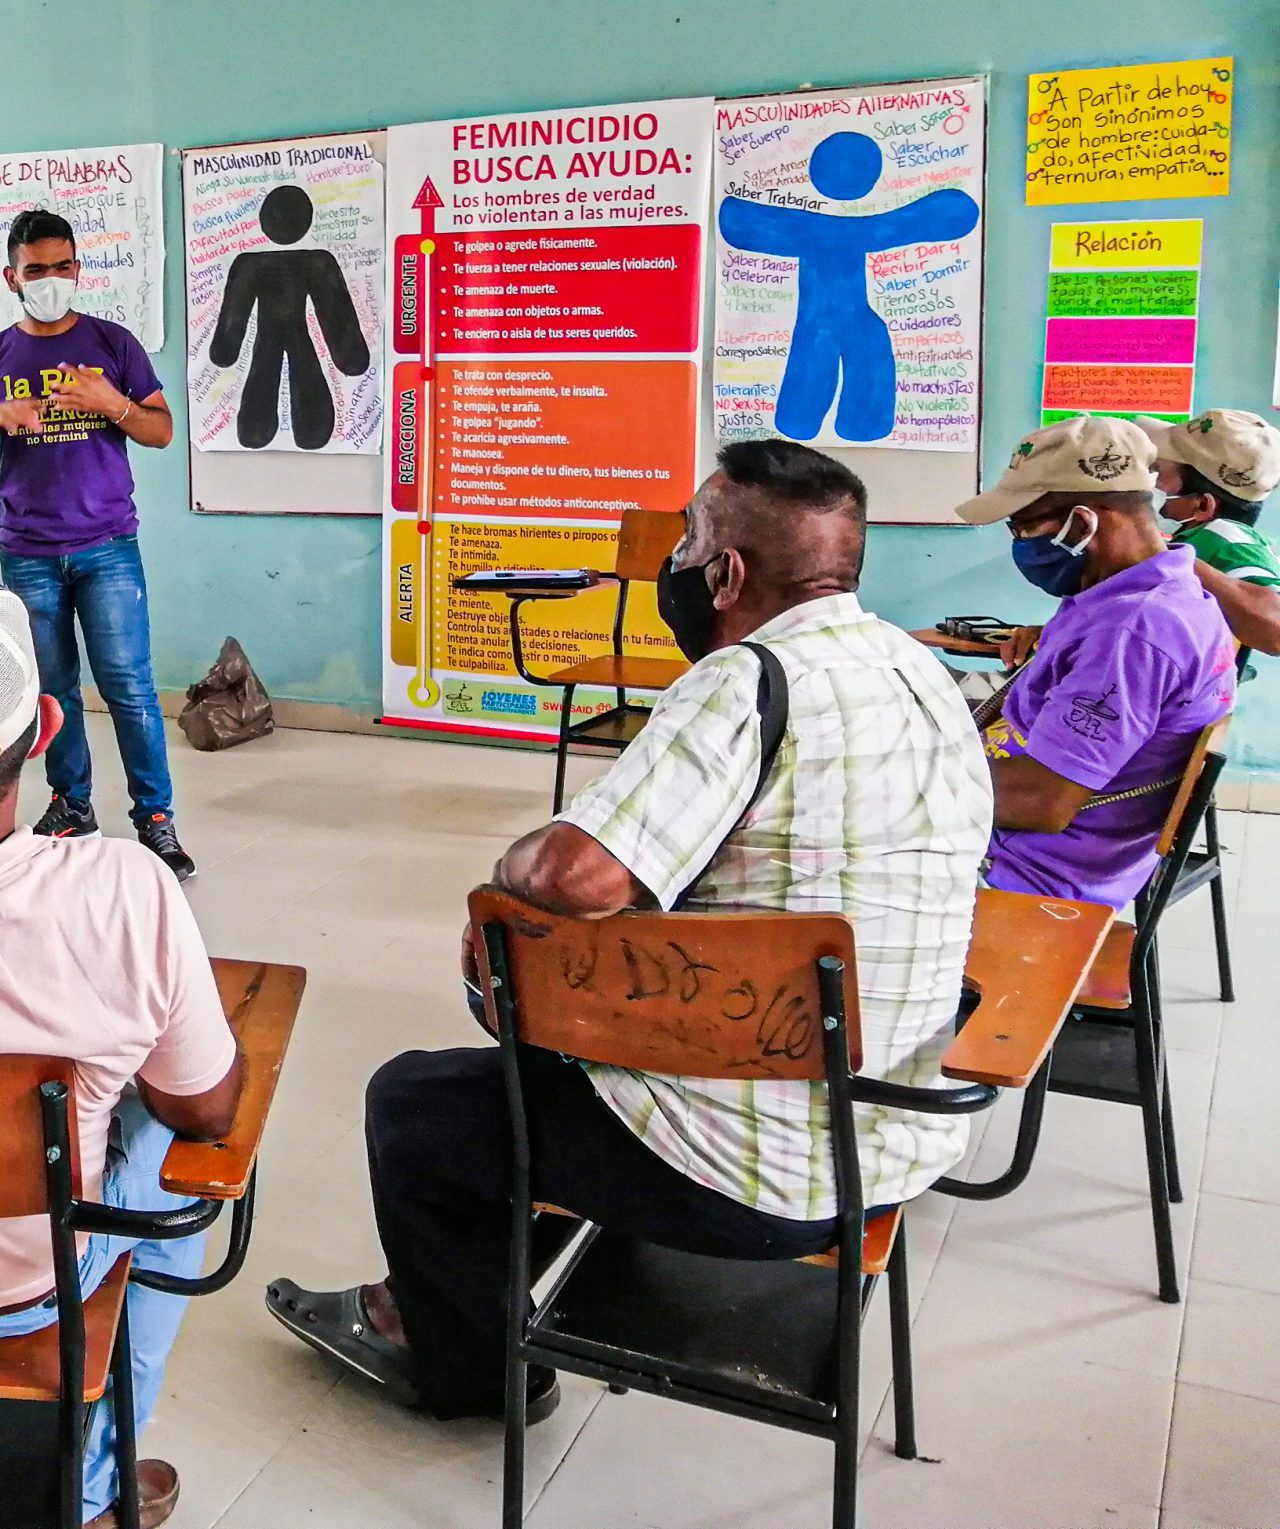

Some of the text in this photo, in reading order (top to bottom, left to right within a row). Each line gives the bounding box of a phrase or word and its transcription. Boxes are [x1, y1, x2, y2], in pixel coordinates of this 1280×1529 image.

[1048, 87, 1067, 112] A
[1147, 74, 1172, 100] de
[1176, 75, 1211, 103] hoy
[453, 113, 658, 151] FEMINICIDIO
[1045, 132, 1071, 149] de
[18, 158, 43, 182] DE
[47, 154, 133, 189] PALABRAS
[453, 148, 692, 185] BUSCA AYUDA:
[55, 192, 127, 215] ENFOQUE
[453, 184, 655, 208] Los hombres de verdad
[724, 181, 762, 200] Saber
[765, 188, 829, 210] Trabajar
[453, 204, 689, 225] no violentan a las mujeres.
[453, 241, 464, 252] Te
[465, 241, 495, 254] golpea
[496, 242, 502, 251] o
[505, 239, 538, 253] agrede
[1076, 230, 1162, 257] Relación
[453, 256, 678, 274] Te fuerza a tener relaciones sexuales (violación).
[400, 253, 417, 336] URGENTE
[453, 284, 558, 296] Te amenaza de muerte.
[453, 305, 604, 319] Te amenaza con objetos o armas.
[453, 328, 465, 339] Te
[465, 328, 500, 339] encierra
[502, 329, 507, 338] o
[533, 327, 546, 338] de
[548, 328, 564, 338] tus
[565, 329, 591, 338] seres
[592, 326, 638, 340] queridos.
[3, 375, 32, 401] la
[453, 385, 608, 398] Te ofende verbalmente, te insulta.
[43, 424, 60, 432] las
[63, 420, 107, 432] mujeres
[452, 416, 463, 427] Te
[463, 417, 492, 429] golpea
[27, 431, 89, 445] no termina
[399, 388, 416, 485] REACCIONA
[451, 447, 504, 459] Te manosea.
[451, 462, 670, 480] Maneja y dispone de tu dinero, tus bienes o tus
[451, 478, 507, 491] documentos.
[450, 524, 460, 535] Te
[461, 526, 482, 536] hace
[484, 527, 518, 538] bromas
[520, 528, 562, 539] hirientes
[564, 531, 570, 540] o
[572, 530, 608, 542] piropos
[449, 536, 503, 549] Te amenaza.
[448, 548, 499, 561] Te intimida.
[399, 562, 413, 624] ALERTA
[447, 597, 493, 610] Te miente.
[447, 656, 508, 671] Te culpabiliza.
